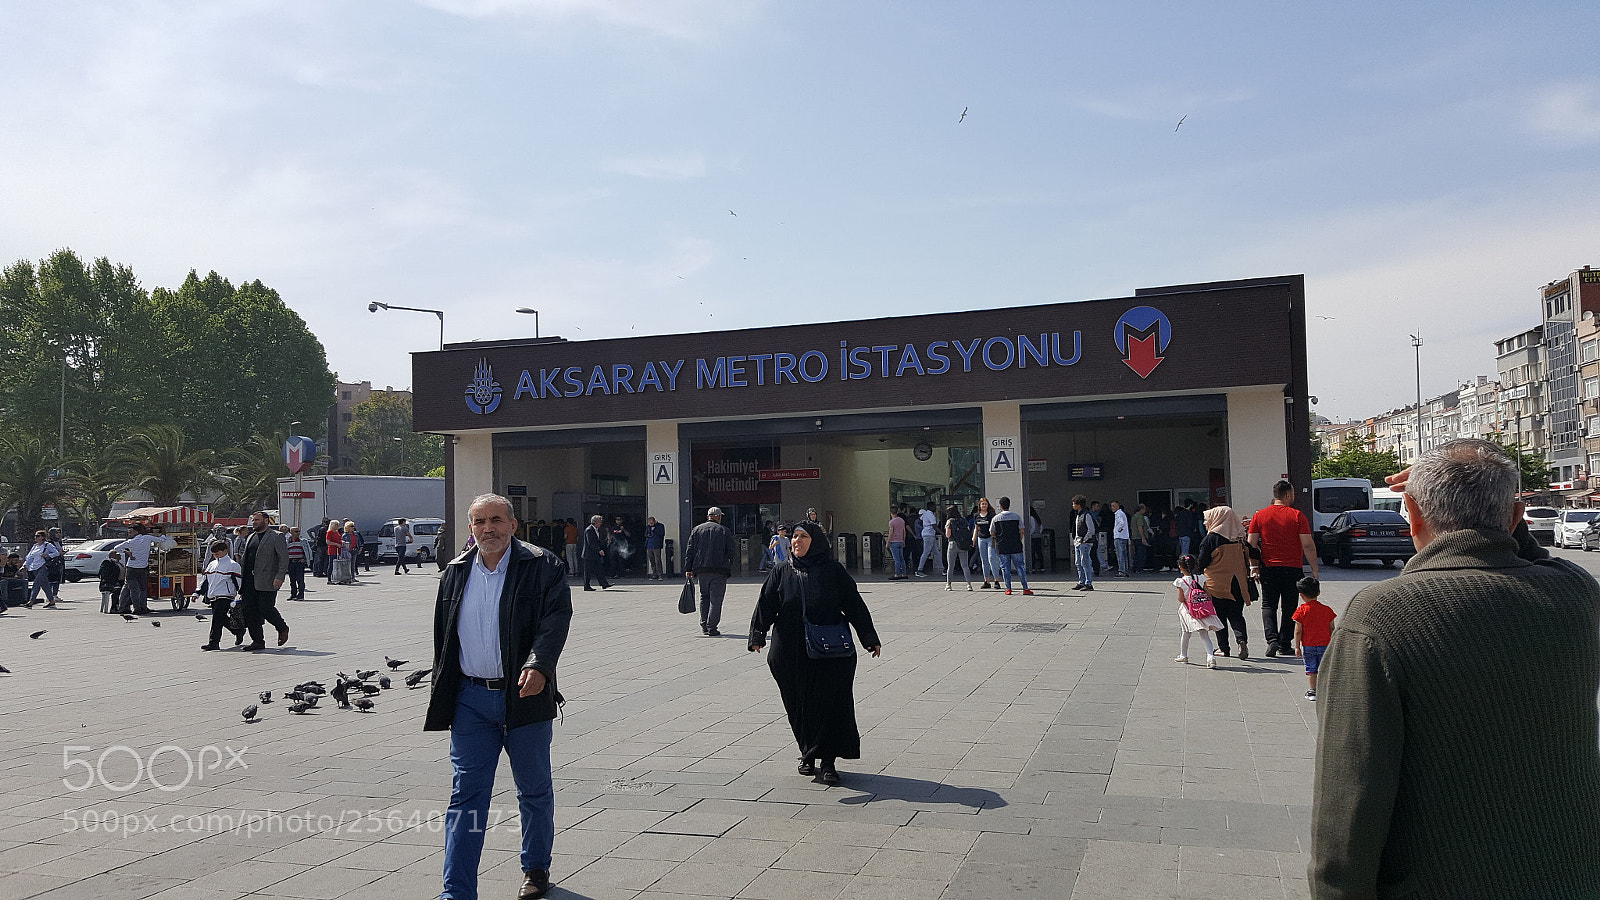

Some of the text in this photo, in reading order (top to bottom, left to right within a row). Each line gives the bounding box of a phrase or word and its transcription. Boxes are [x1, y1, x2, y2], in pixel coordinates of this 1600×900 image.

[513, 330, 1082, 400] AKSARAY METRO İSTASYONU
[707, 459, 759, 475] Hakimiyet
[994, 451, 1012, 469] A
[656, 465, 671, 481] A
[707, 477, 759, 492] Milletindir
